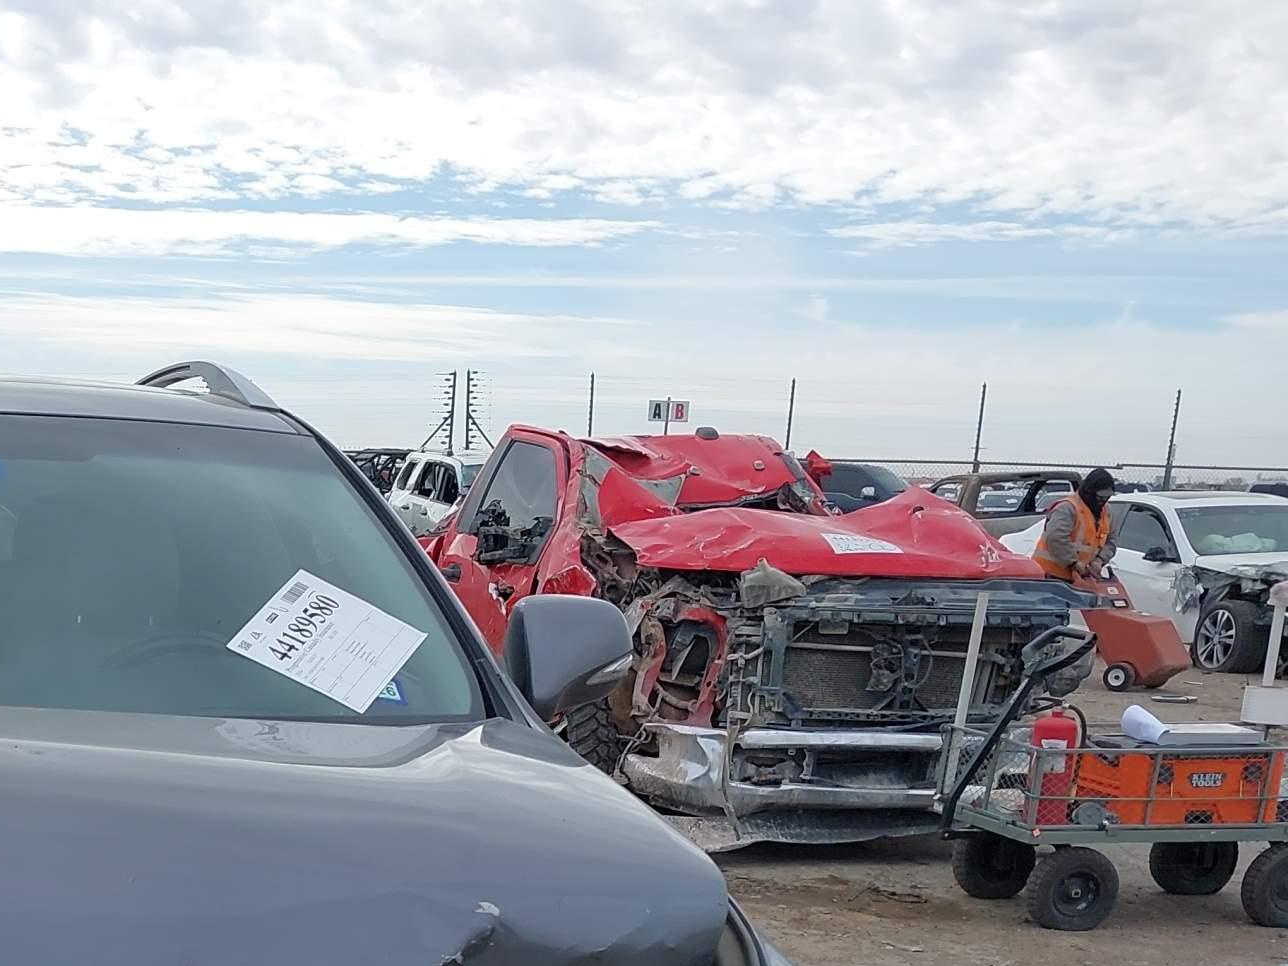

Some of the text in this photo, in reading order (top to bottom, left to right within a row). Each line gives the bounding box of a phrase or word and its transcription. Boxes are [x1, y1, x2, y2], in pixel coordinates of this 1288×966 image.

[652, 403, 685, 420] A B
[268, 594, 340, 661] 44189580
